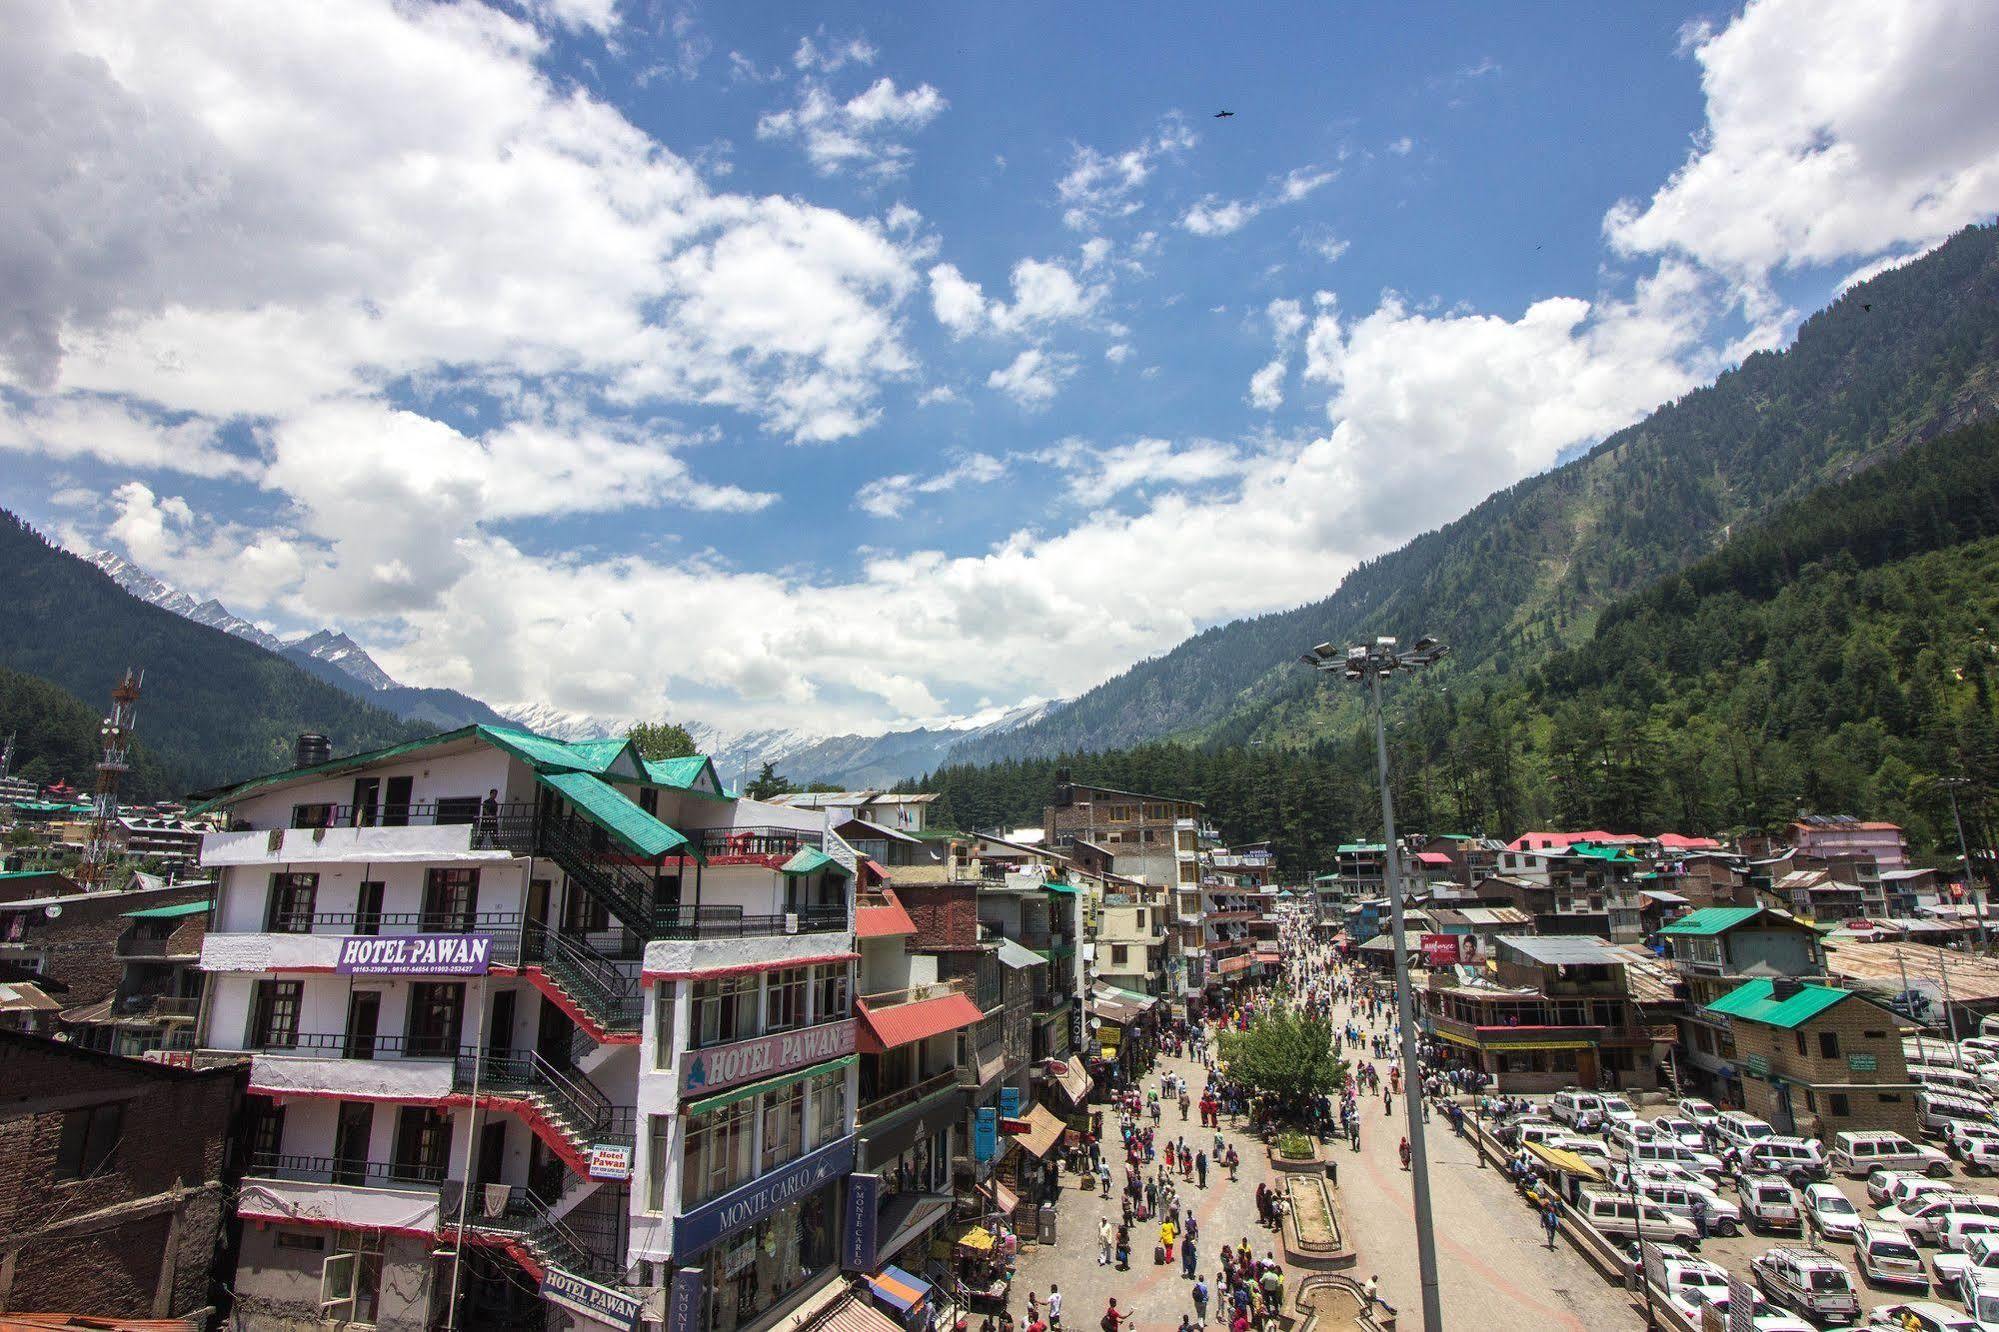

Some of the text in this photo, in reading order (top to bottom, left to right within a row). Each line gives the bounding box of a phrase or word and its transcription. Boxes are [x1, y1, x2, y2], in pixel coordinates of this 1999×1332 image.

[343, 938, 488, 963] HOTEL PAWAN
[1072, 1008, 1081, 1044] SONY
[708, 1041, 774, 1086] HOTEL
[779, 1026, 842, 1067] PAWAN
[593, 1157, 626, 1168] Pawan
[599, 1151, 624, 1160] Hotel
[719, 1168, 810, 1232] MONTE CARLO
[546, 1271, 637, 1319] HOTEL PAWAN
